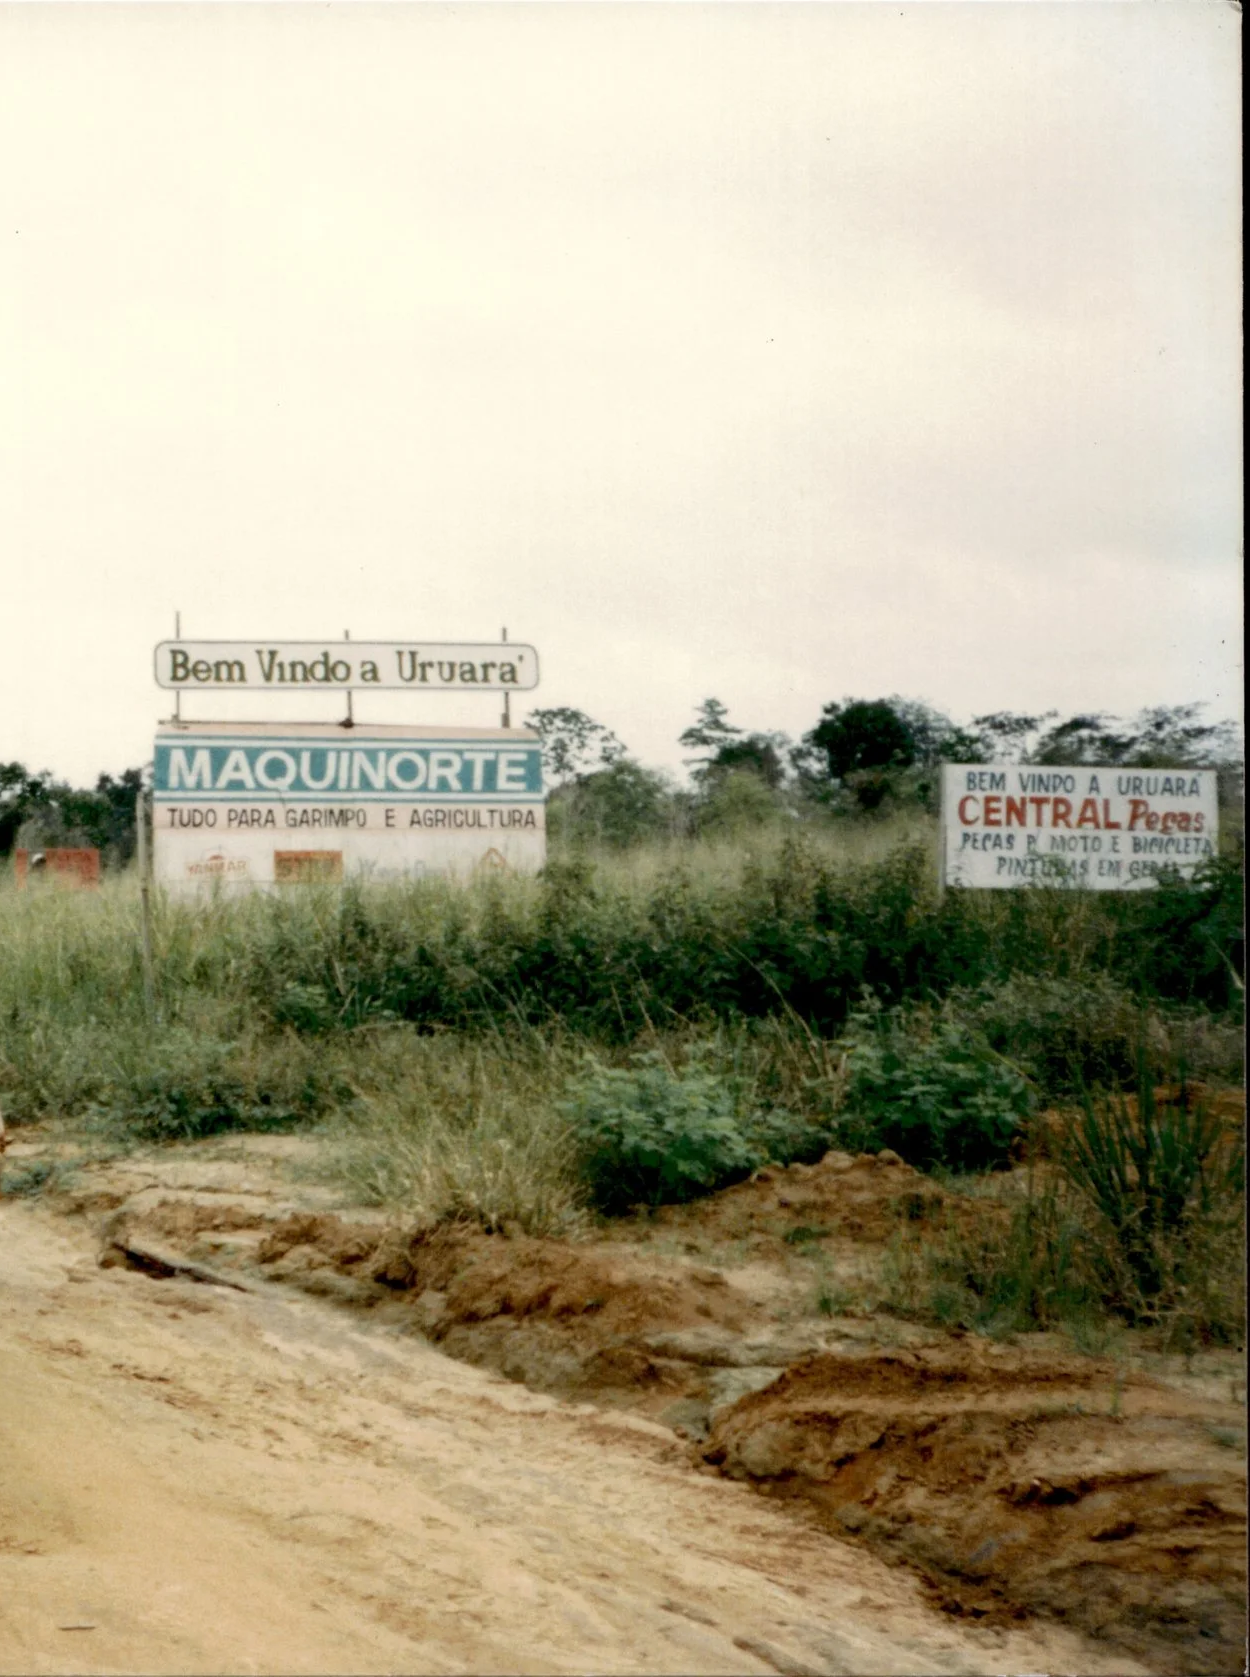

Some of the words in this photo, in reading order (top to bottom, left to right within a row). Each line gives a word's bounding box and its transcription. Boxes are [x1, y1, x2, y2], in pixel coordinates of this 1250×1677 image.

[169, 649, 247, 683] Bem
[255, 650, 350, 683] Vindo
[360, 660, 380, 682] a
[168, 748, 529, 792] MAQUINORTE
[966, 771, 1006, 792] BEM
[1019, 773, 1076, 794] VINDO
[1088, 775, 1100, 793] A
[167, 808, 217, 828] TUDO
[227, 808, 276, 828] PARA
[285, 808, 367, 829] GARIMPO
[385, 809, 396, 828] E
[409, 809, 537, 829] AGRICULTURA
[958, 796, 1121, 830] CENTRAL
[1128, 799, 1205, 835] Peças
[1052, 834, 1101, 852] MOTO
[1112, 835, 1120, 853] E
[1132, 836, 1213, 855] BICICLETA
[1097, 858, 1121, 877] EM
